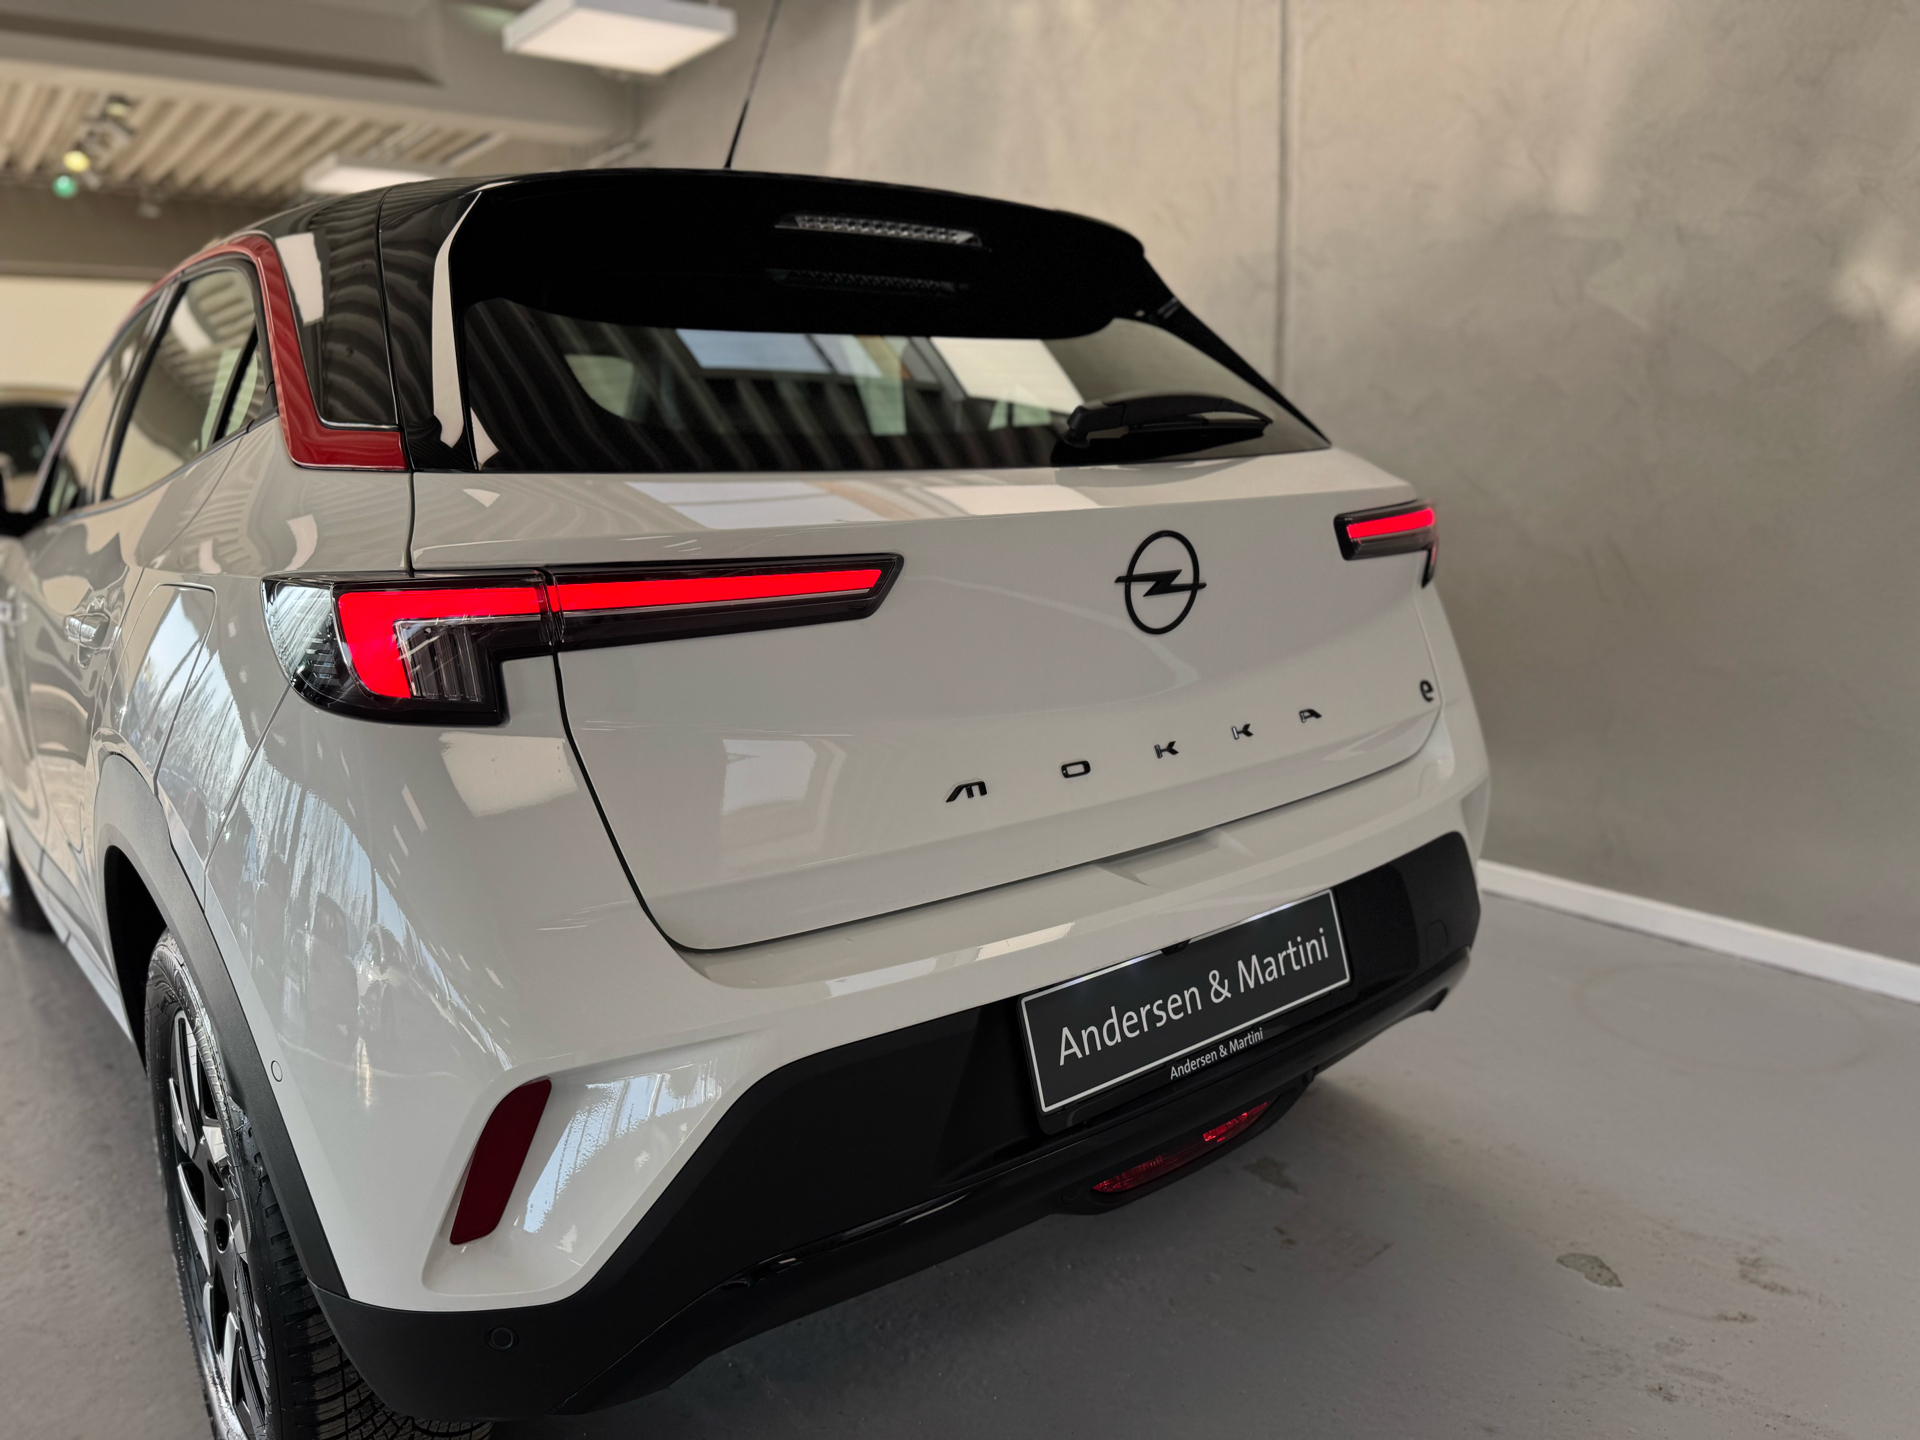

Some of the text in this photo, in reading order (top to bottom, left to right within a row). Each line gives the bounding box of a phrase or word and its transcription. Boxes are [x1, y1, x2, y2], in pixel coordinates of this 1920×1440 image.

[945, 679, 1434, 803] MOKKA e
[1059, 927, 1329, 1066] Andersen & Martini
[1170, 1027, 1264, 1080] Andersen & Martini
